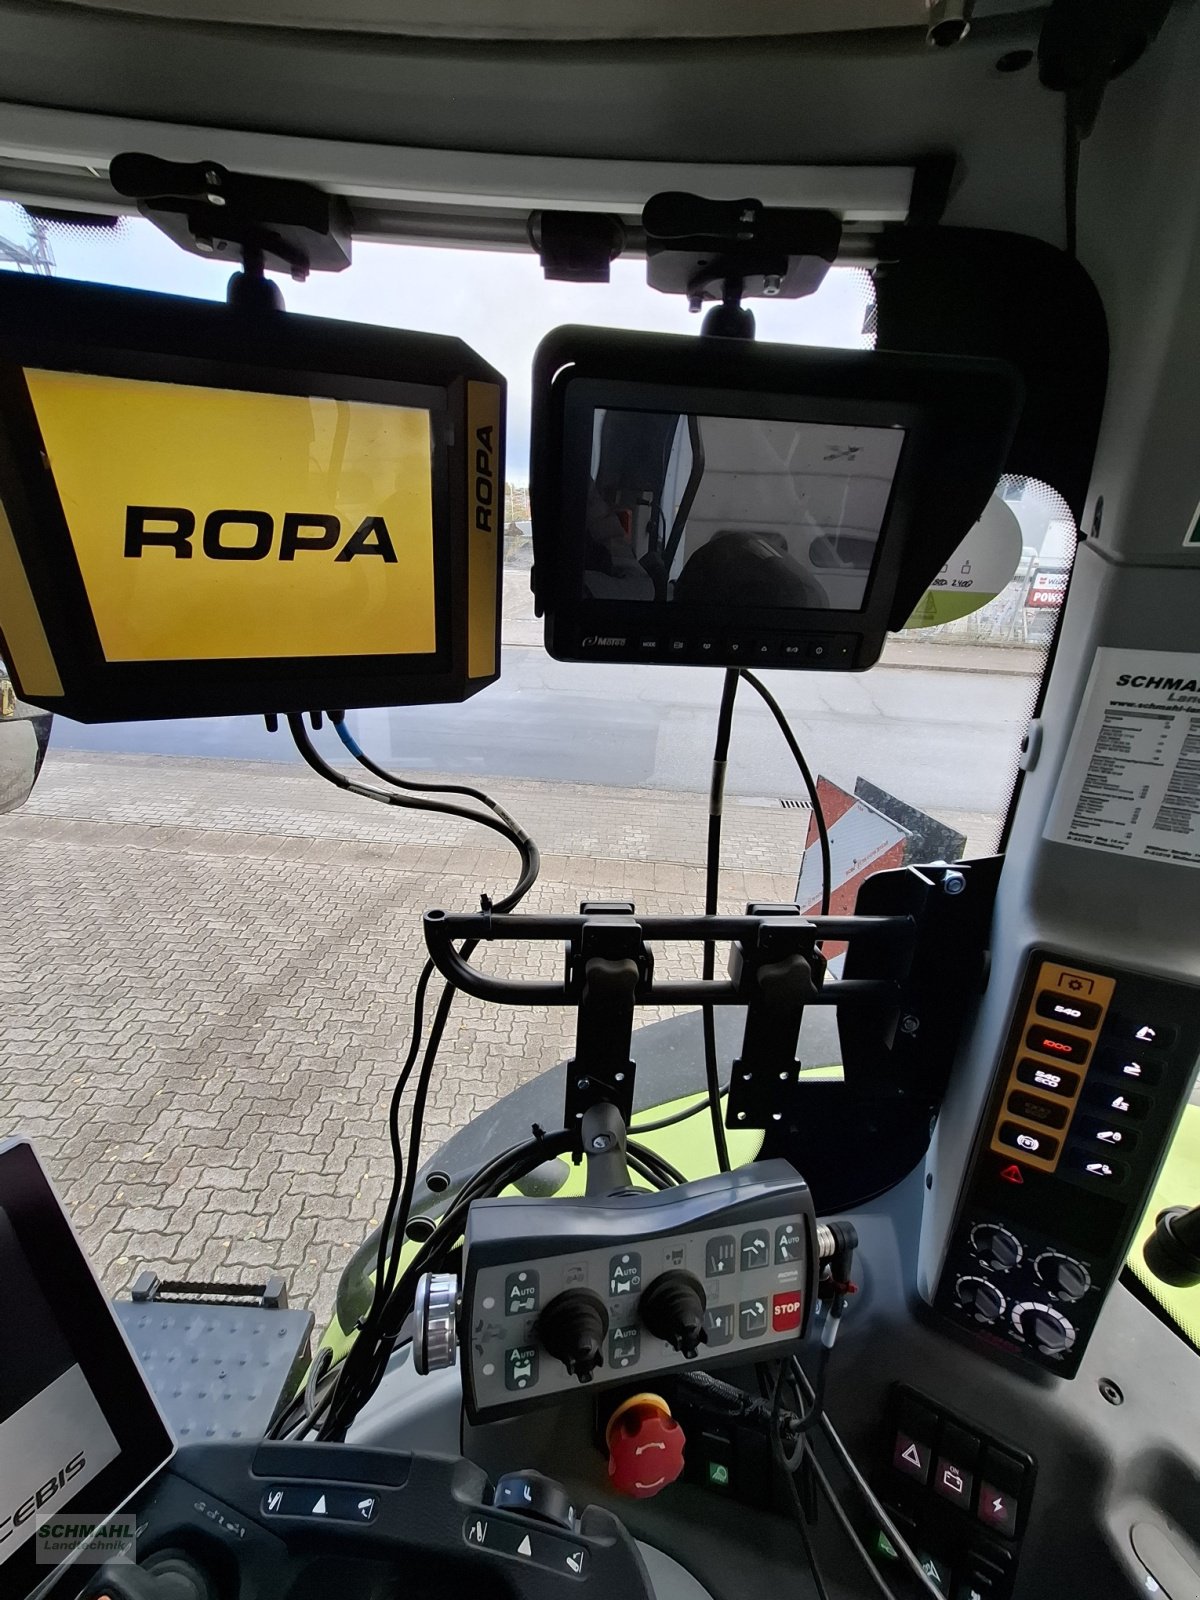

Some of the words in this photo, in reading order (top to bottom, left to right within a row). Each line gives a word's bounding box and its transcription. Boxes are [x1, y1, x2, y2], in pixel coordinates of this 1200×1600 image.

[475, 424, 493, 533] ROPA
[123, 505, 399, 564] ROPA
[1116, 674, 1200, 693] SCHMA
[1054, 1005, 1081, 1018] 540
[1043, 1039, 1072, 1052] 1000
[1034, 1076, 1058, 1088] ECO
[1035, 1070, 1061, 1082] 540
[774, 1301, 801, 1316] STOP
[949, 1465, 960, 1475] ON
